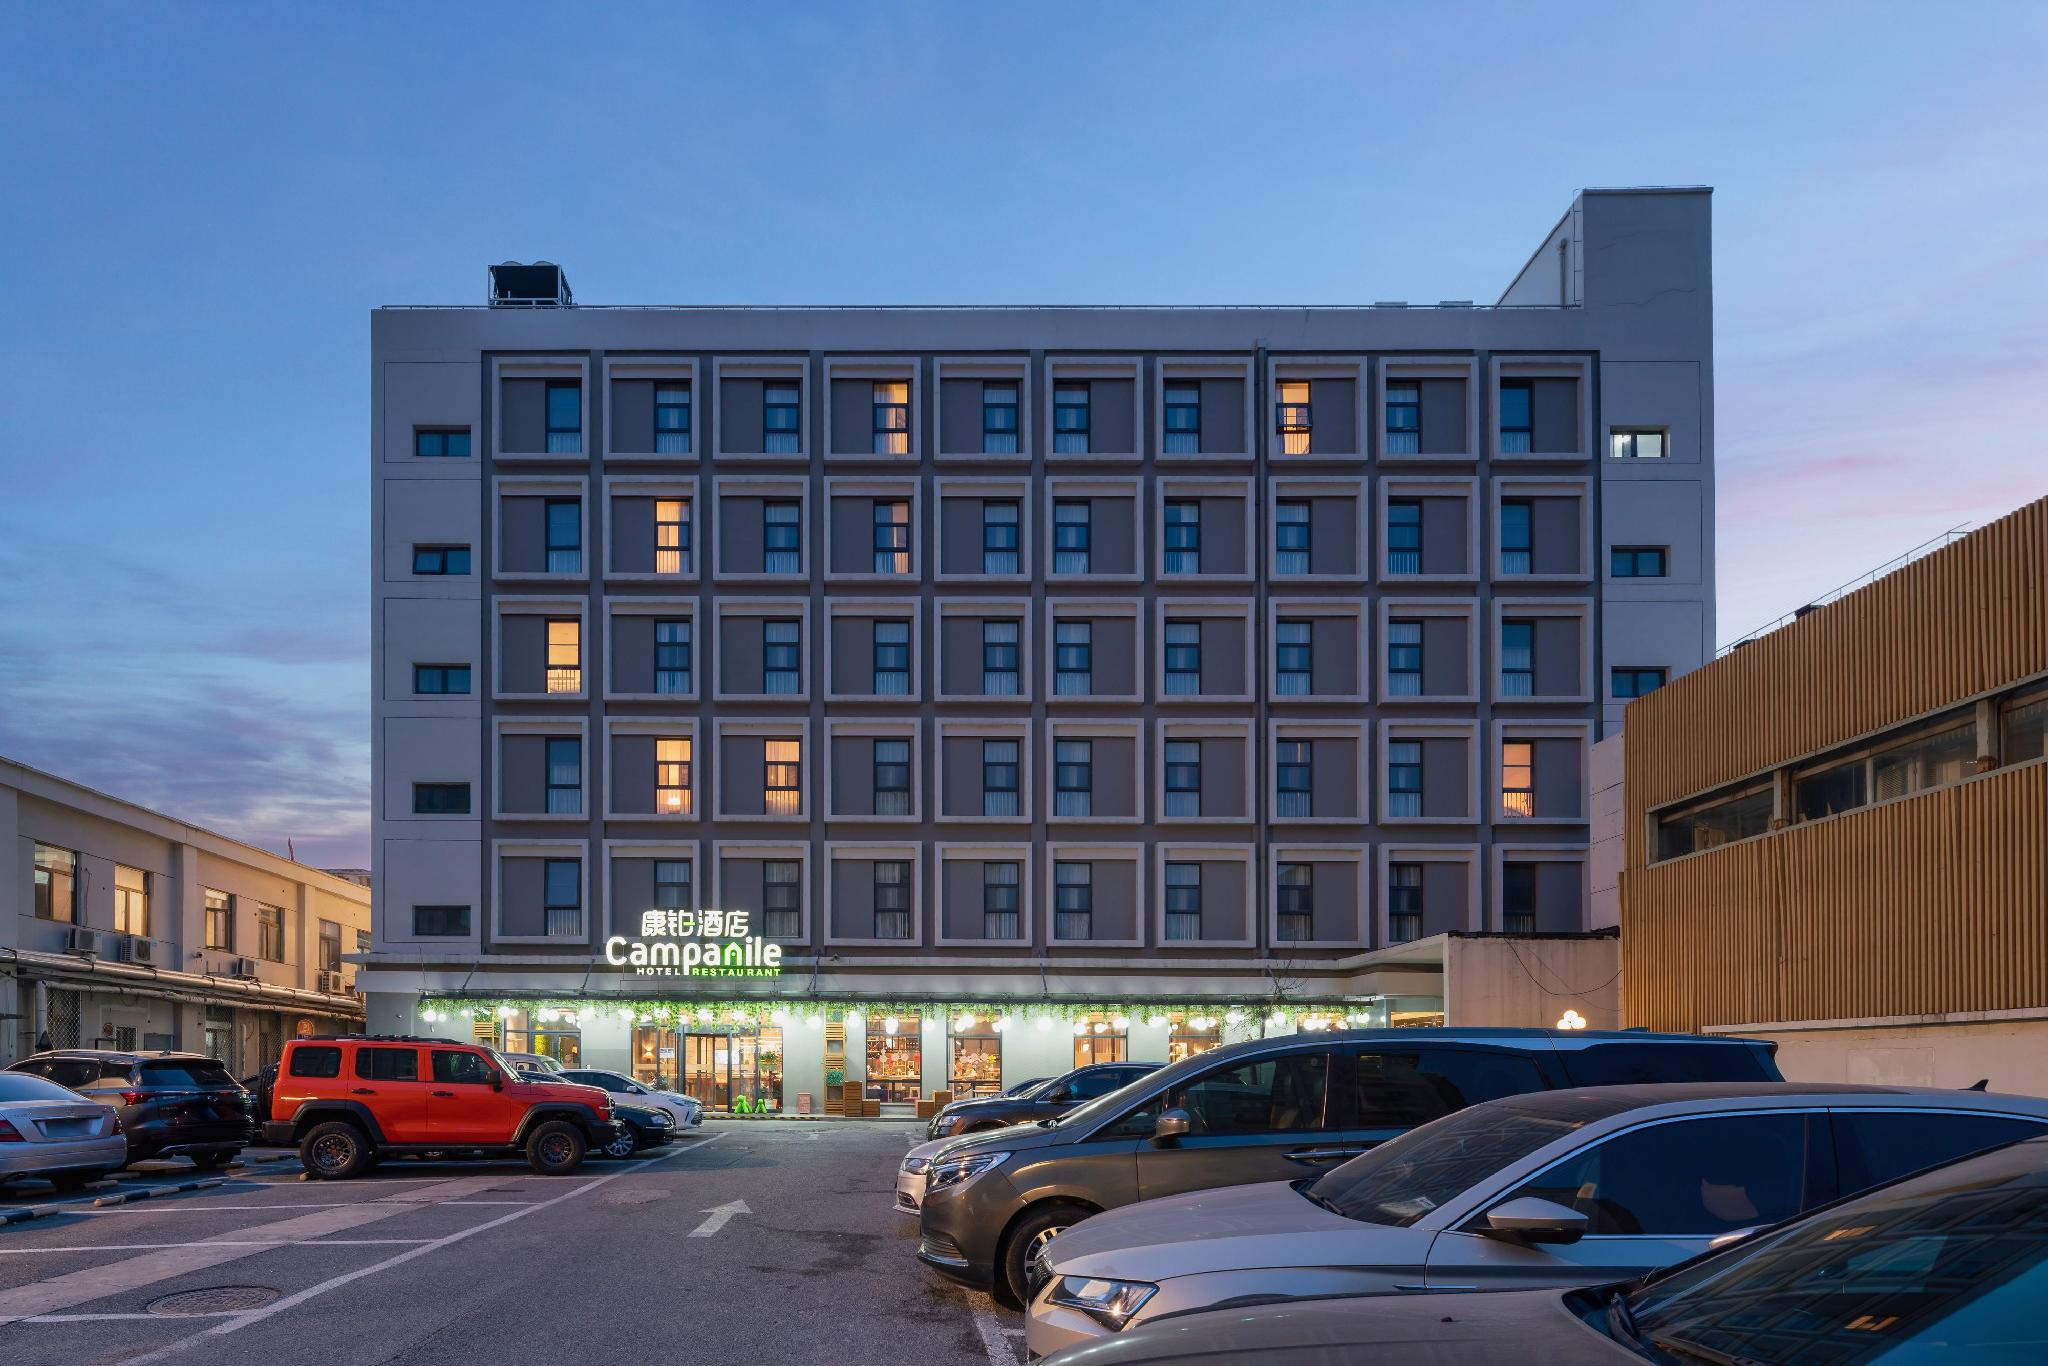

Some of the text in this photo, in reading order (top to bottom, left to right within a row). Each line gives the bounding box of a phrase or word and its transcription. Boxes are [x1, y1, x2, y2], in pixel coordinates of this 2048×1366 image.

[641, 909, 750, 938] 康铂酒店
[605, 936, 783, 976] Campanile
[636, 967, 781, 977] HOTEL RESTAURANT
